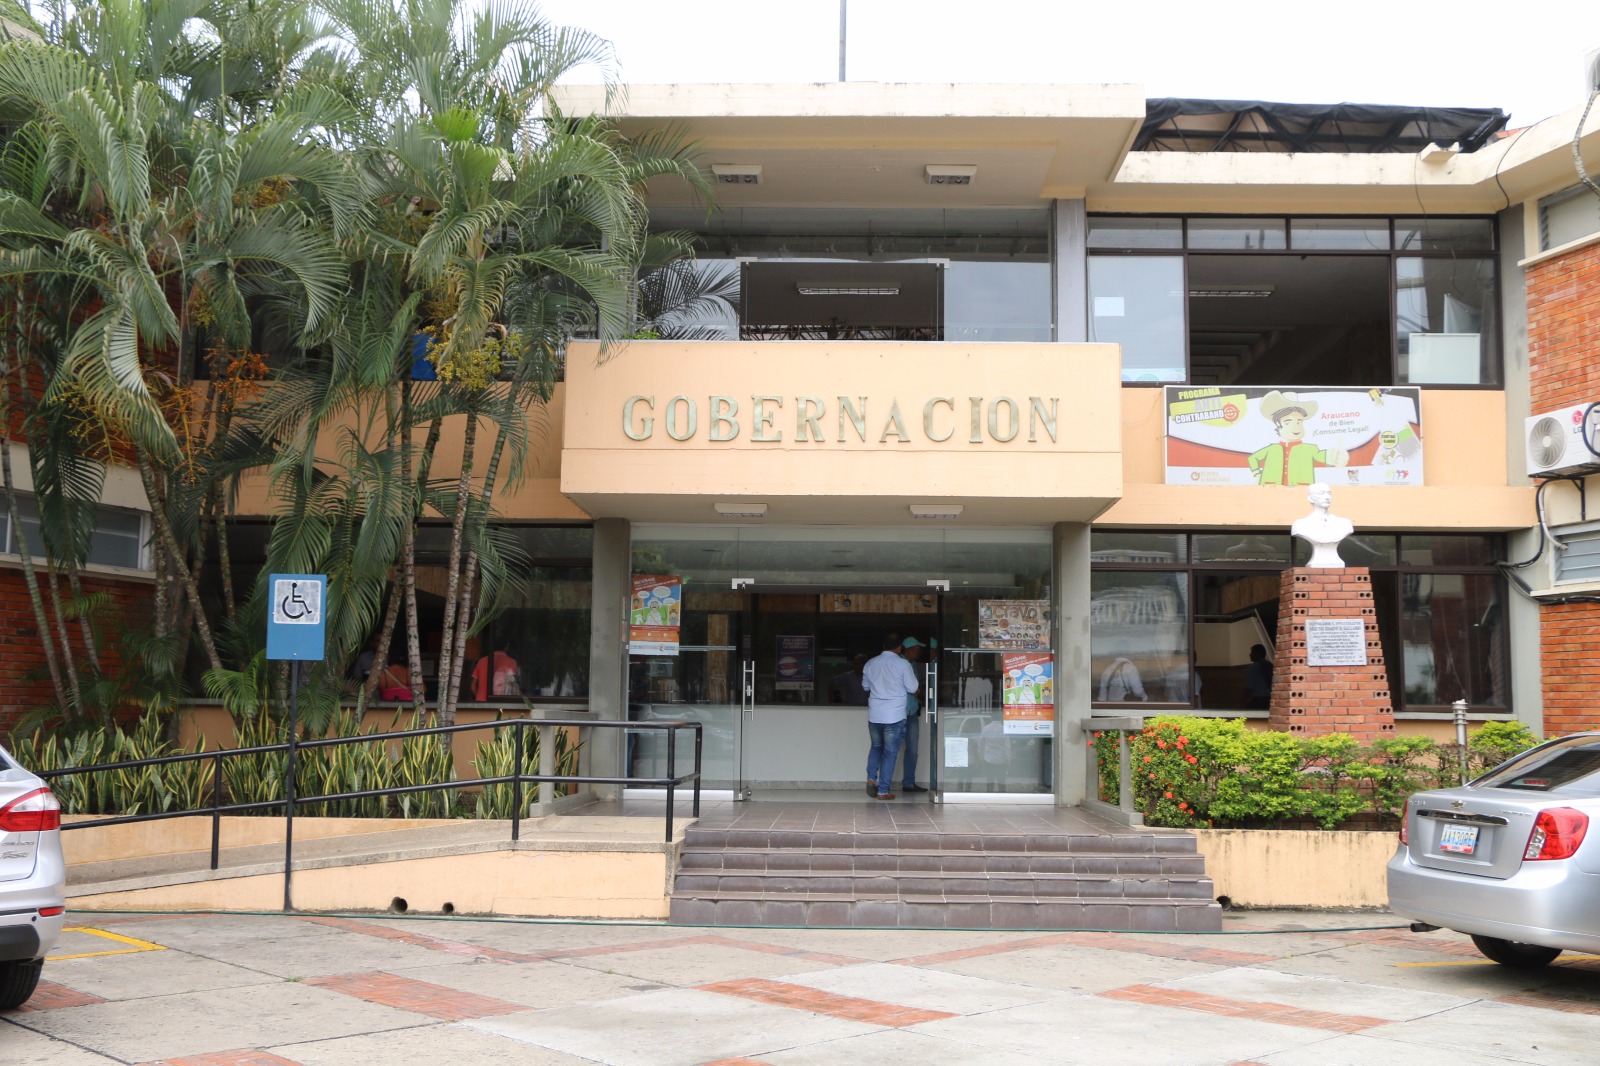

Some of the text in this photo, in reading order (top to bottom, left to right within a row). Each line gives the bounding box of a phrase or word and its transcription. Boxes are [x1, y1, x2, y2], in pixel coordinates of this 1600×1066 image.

[1178, 387, 1221, 400] PROGRAMA
[623, 395, 1060, 443] GOBERNACION
[1321, 412, 1361, 420] Araucano
[1339, 419, 1355, 427] Bien
[1348, 425, 1370, 434] Legal!
